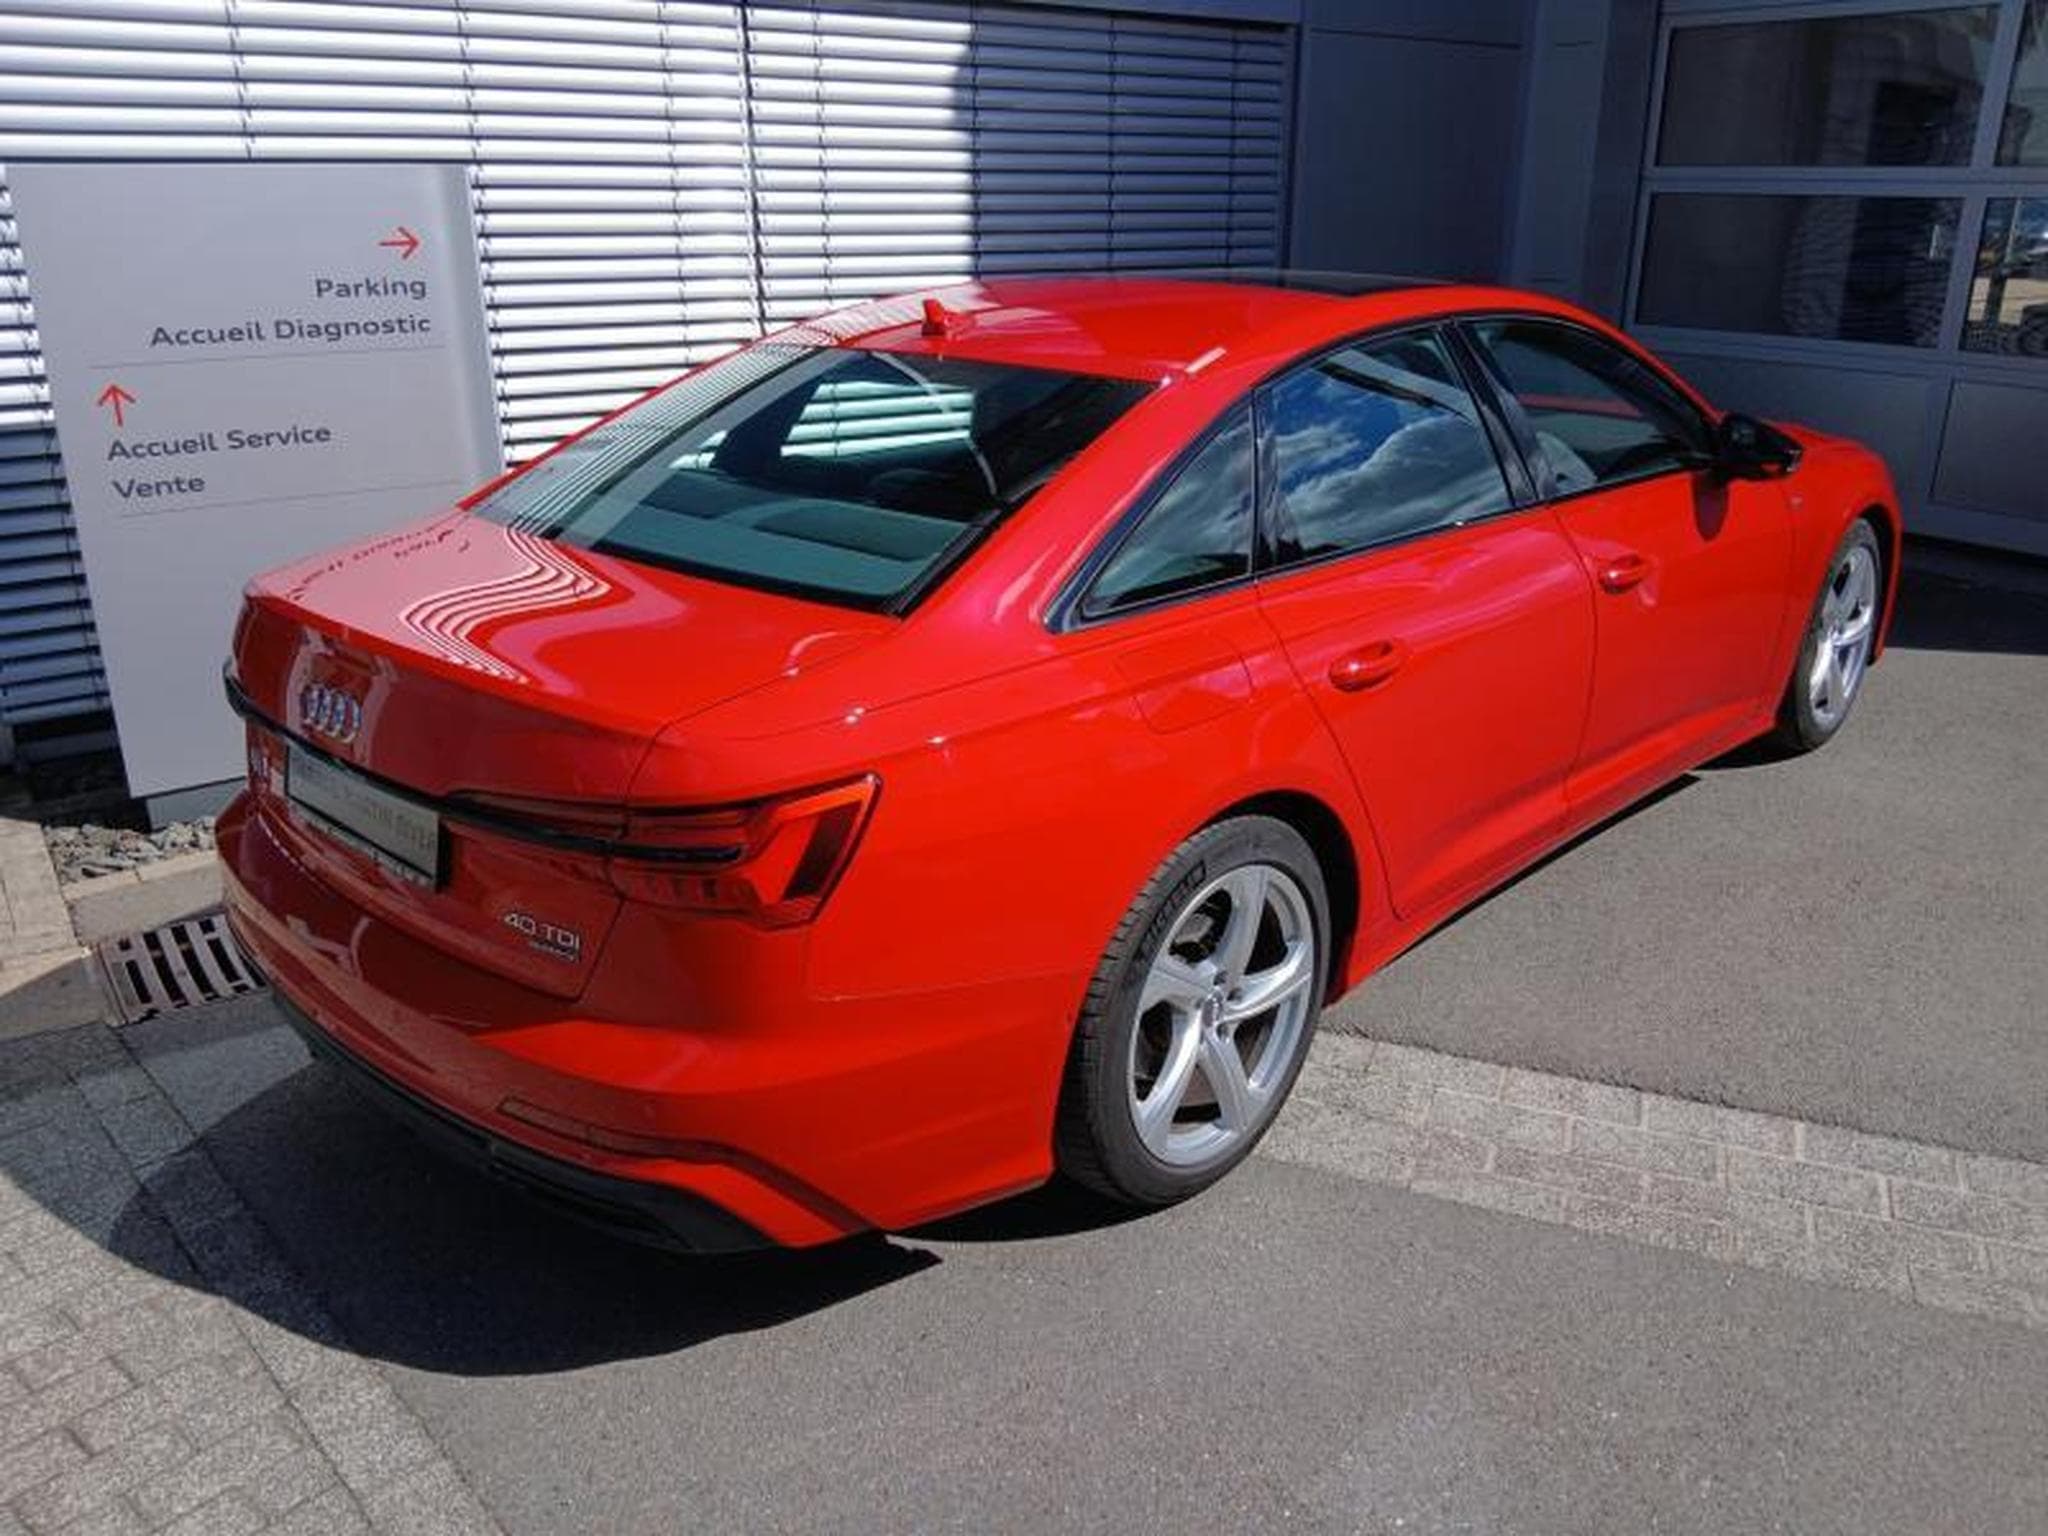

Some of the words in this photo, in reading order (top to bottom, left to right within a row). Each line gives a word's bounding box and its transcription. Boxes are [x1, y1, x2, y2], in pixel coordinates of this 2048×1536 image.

[315, 276, 427, 301] Parking
[150, 320, 265, 347] Accueil
[273, 313, 431, 343] Diagnostic
[106, 432, 218, 462] Accueil
[226, 424, 332, 450] Service
[111, 475, 205, 500] Vente
[503, 912, 537, 936] 40
[541, 923, 580, 951] TDI
